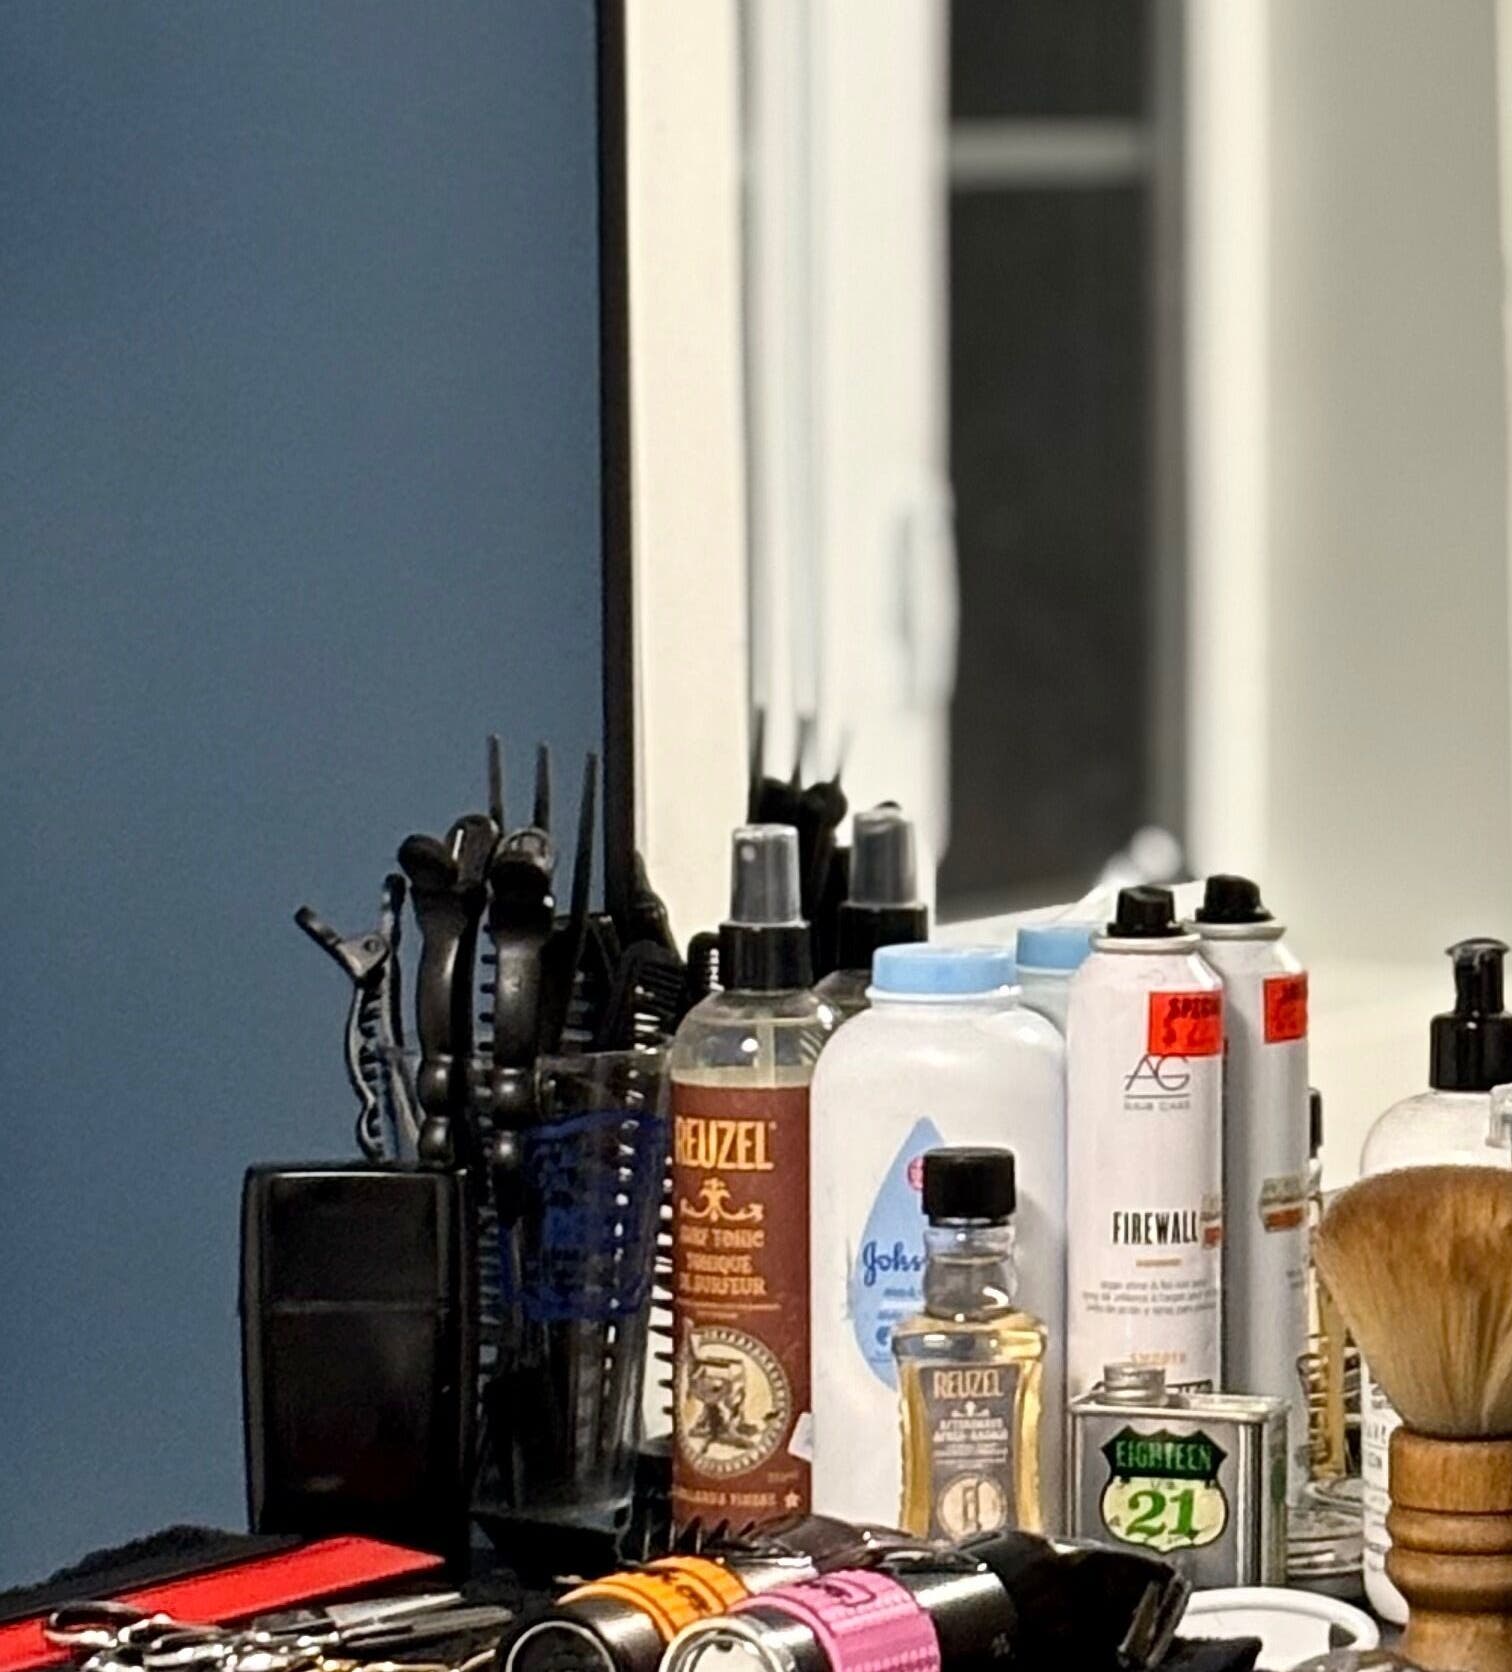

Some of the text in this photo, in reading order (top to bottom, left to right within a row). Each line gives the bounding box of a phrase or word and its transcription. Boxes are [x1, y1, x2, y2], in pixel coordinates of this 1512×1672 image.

[1124, 1053, 1190, 1091] AG
[675, 1116, 775, 1170] REUZEL
[1112, 1211, 1199, 1245] FIREWALL
[933, 1369, 1005, 1399] REUZEL
[1115, 1440, 1212, 1471] EIGHTEEN
[1126, 1488, 1201, 1538] 21
